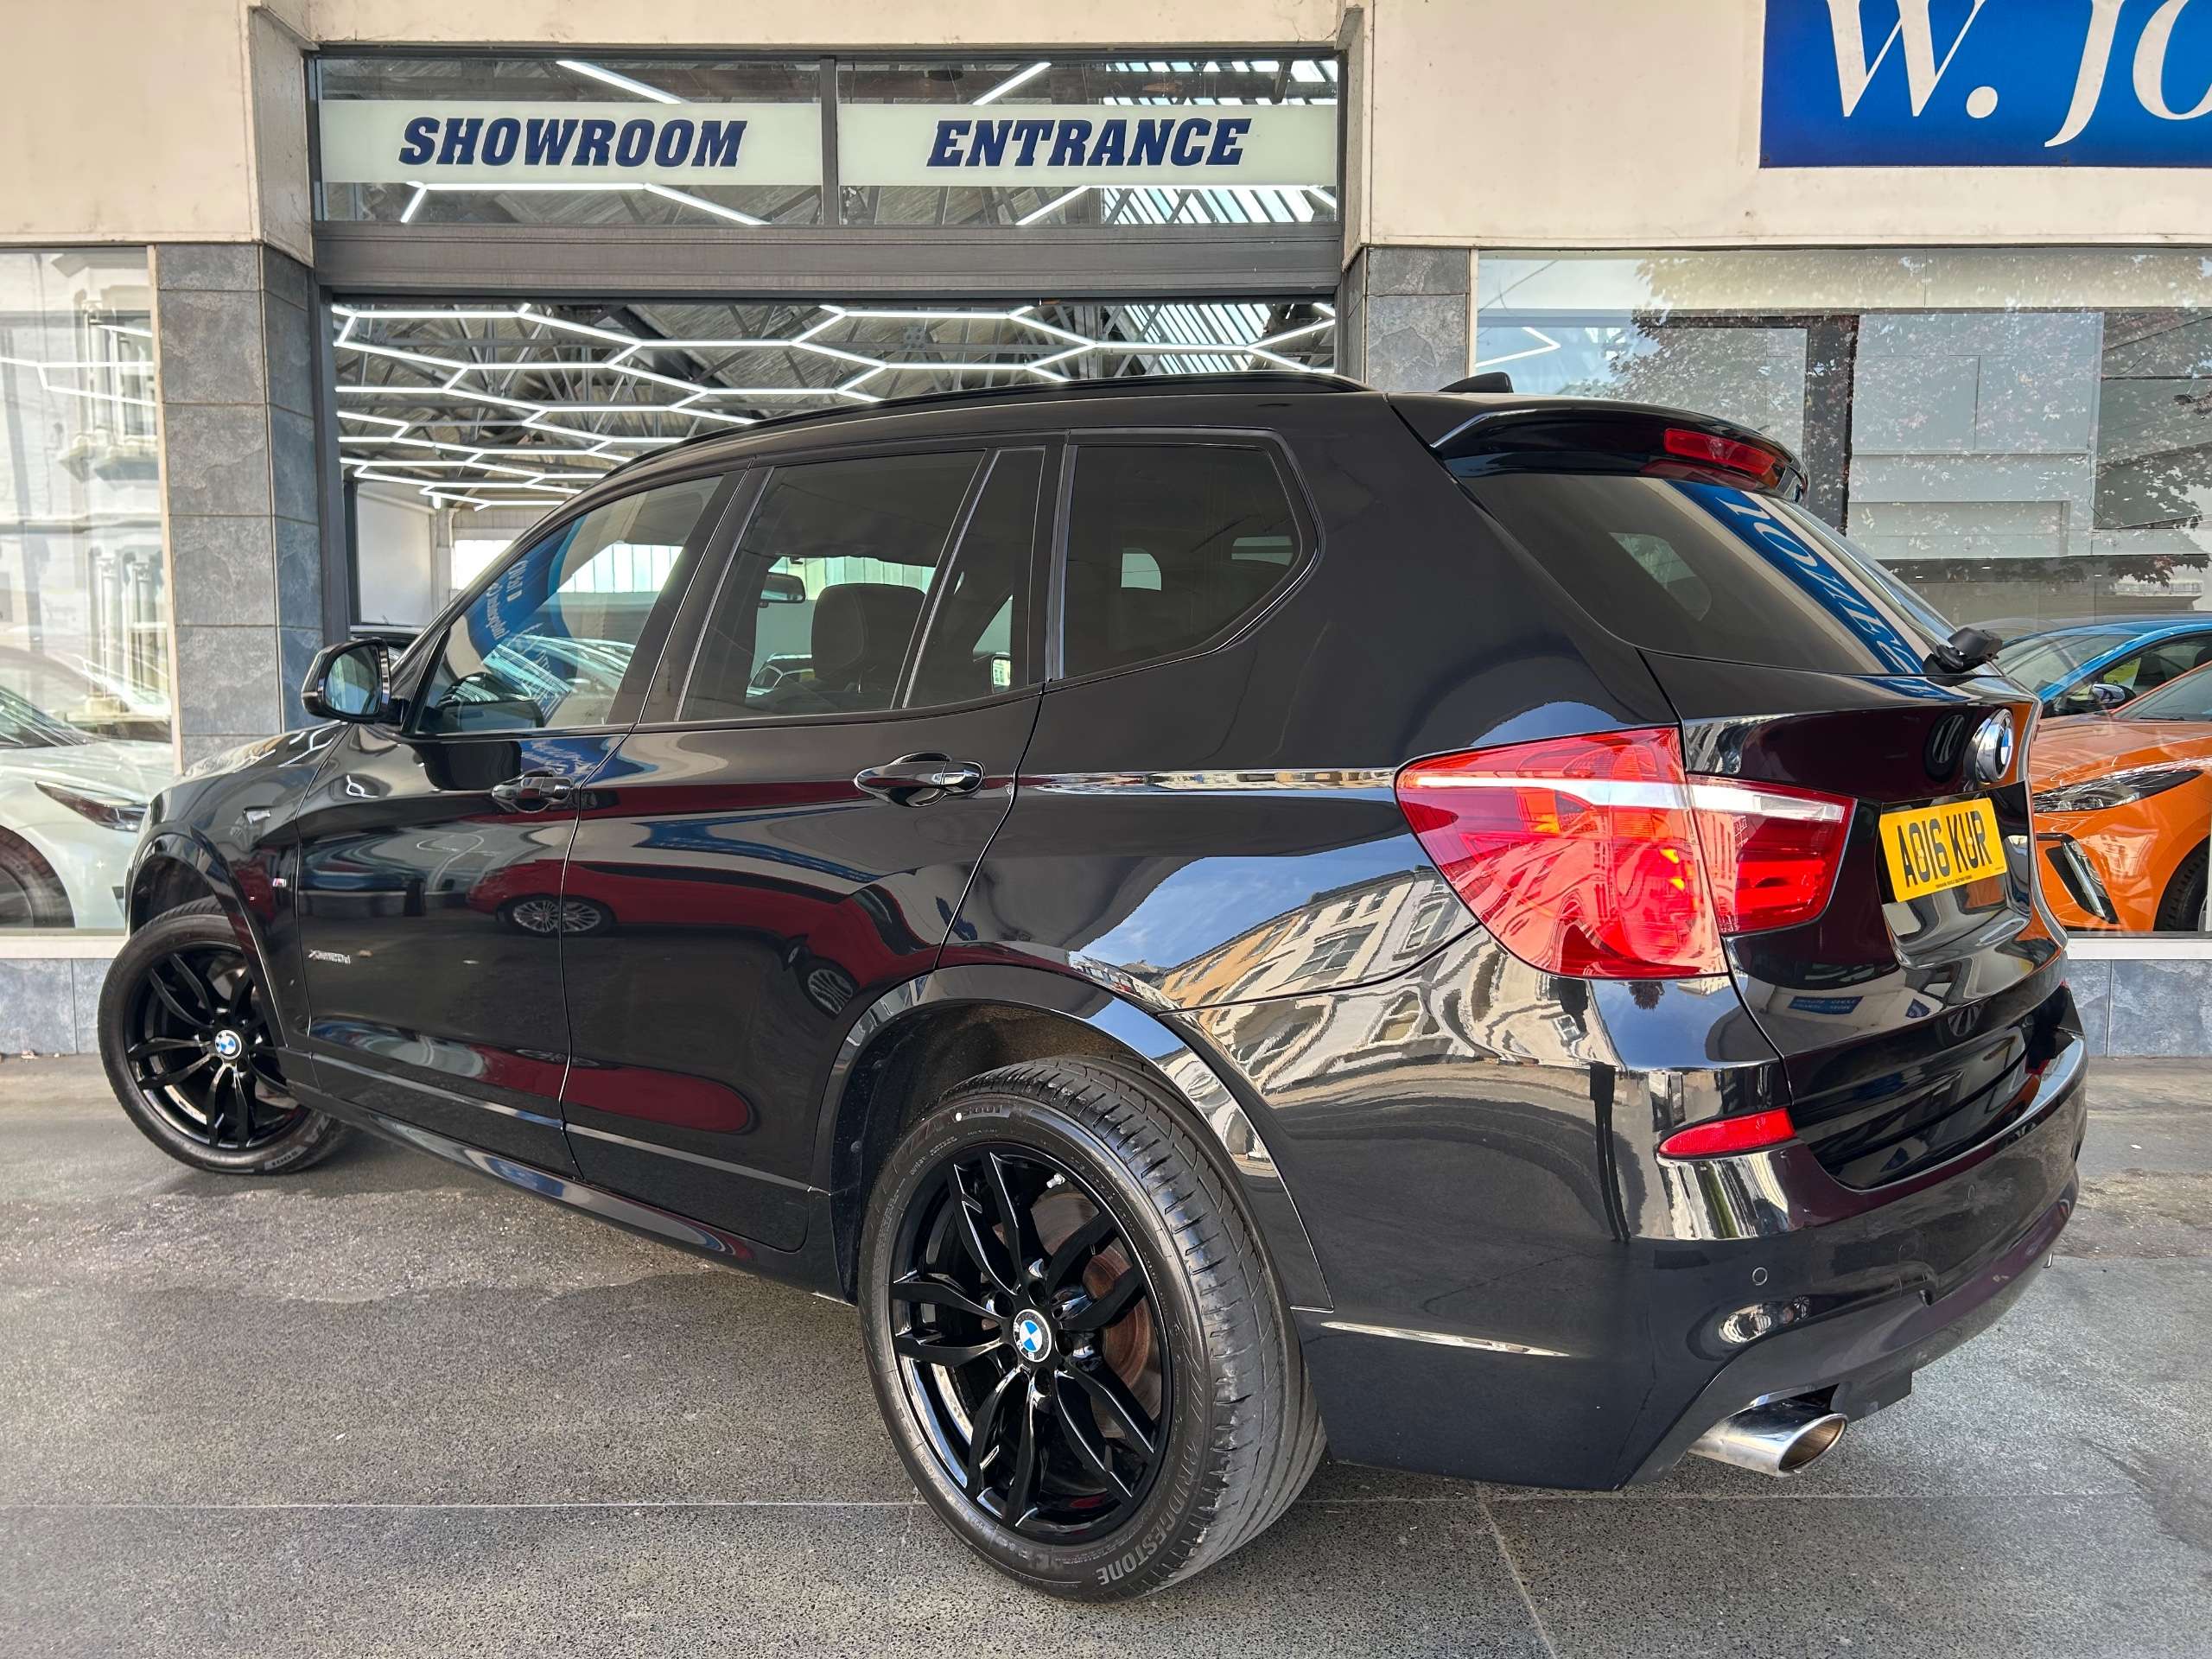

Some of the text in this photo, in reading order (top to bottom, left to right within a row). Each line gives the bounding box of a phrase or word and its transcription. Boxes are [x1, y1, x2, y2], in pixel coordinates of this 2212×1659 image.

[1826, 0, 1999, 119] W.
[398, 117, 1252, 168] SHOWROOM ENTRANCE
[1897, 810, 1993, 888] AO16 KUR
